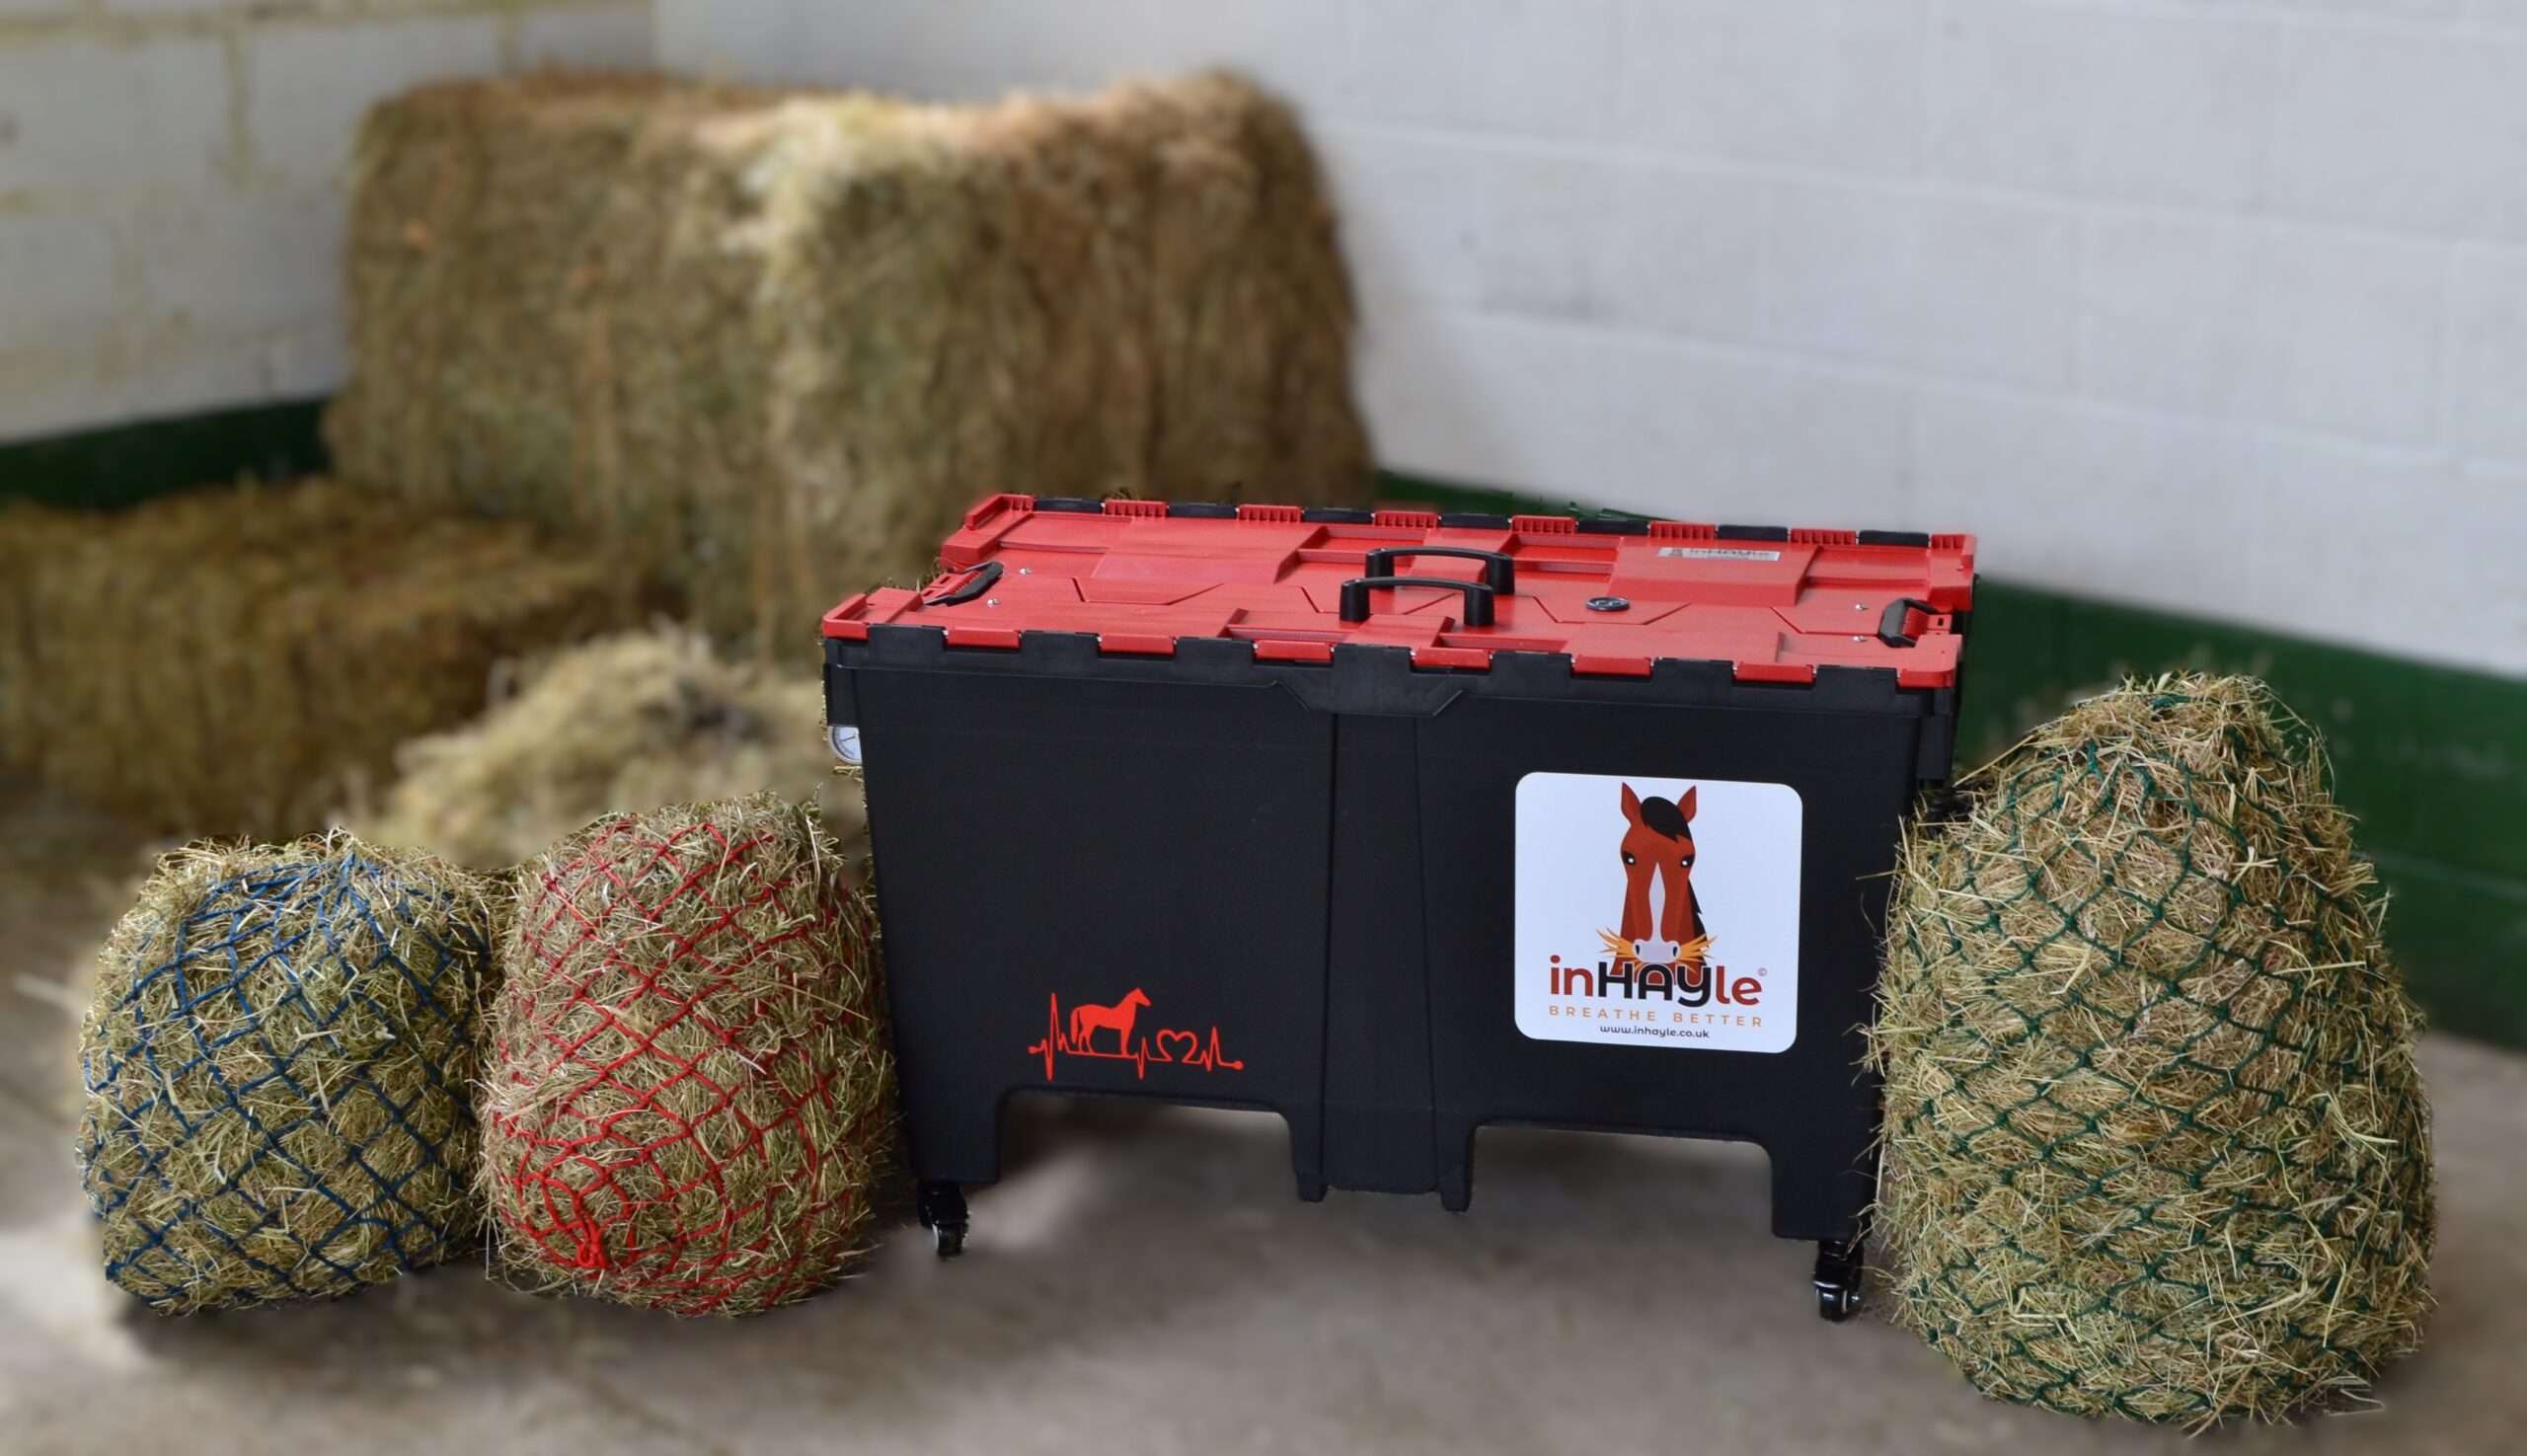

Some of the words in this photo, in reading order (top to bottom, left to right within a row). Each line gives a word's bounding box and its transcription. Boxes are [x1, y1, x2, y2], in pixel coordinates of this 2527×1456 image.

[1549, 1005, 1656, 1022] BREATHE
[1673, 1012, 1762, 1028] BETTER
[1599, 1025, 1710, 1038] www.inhayle.co.uk
